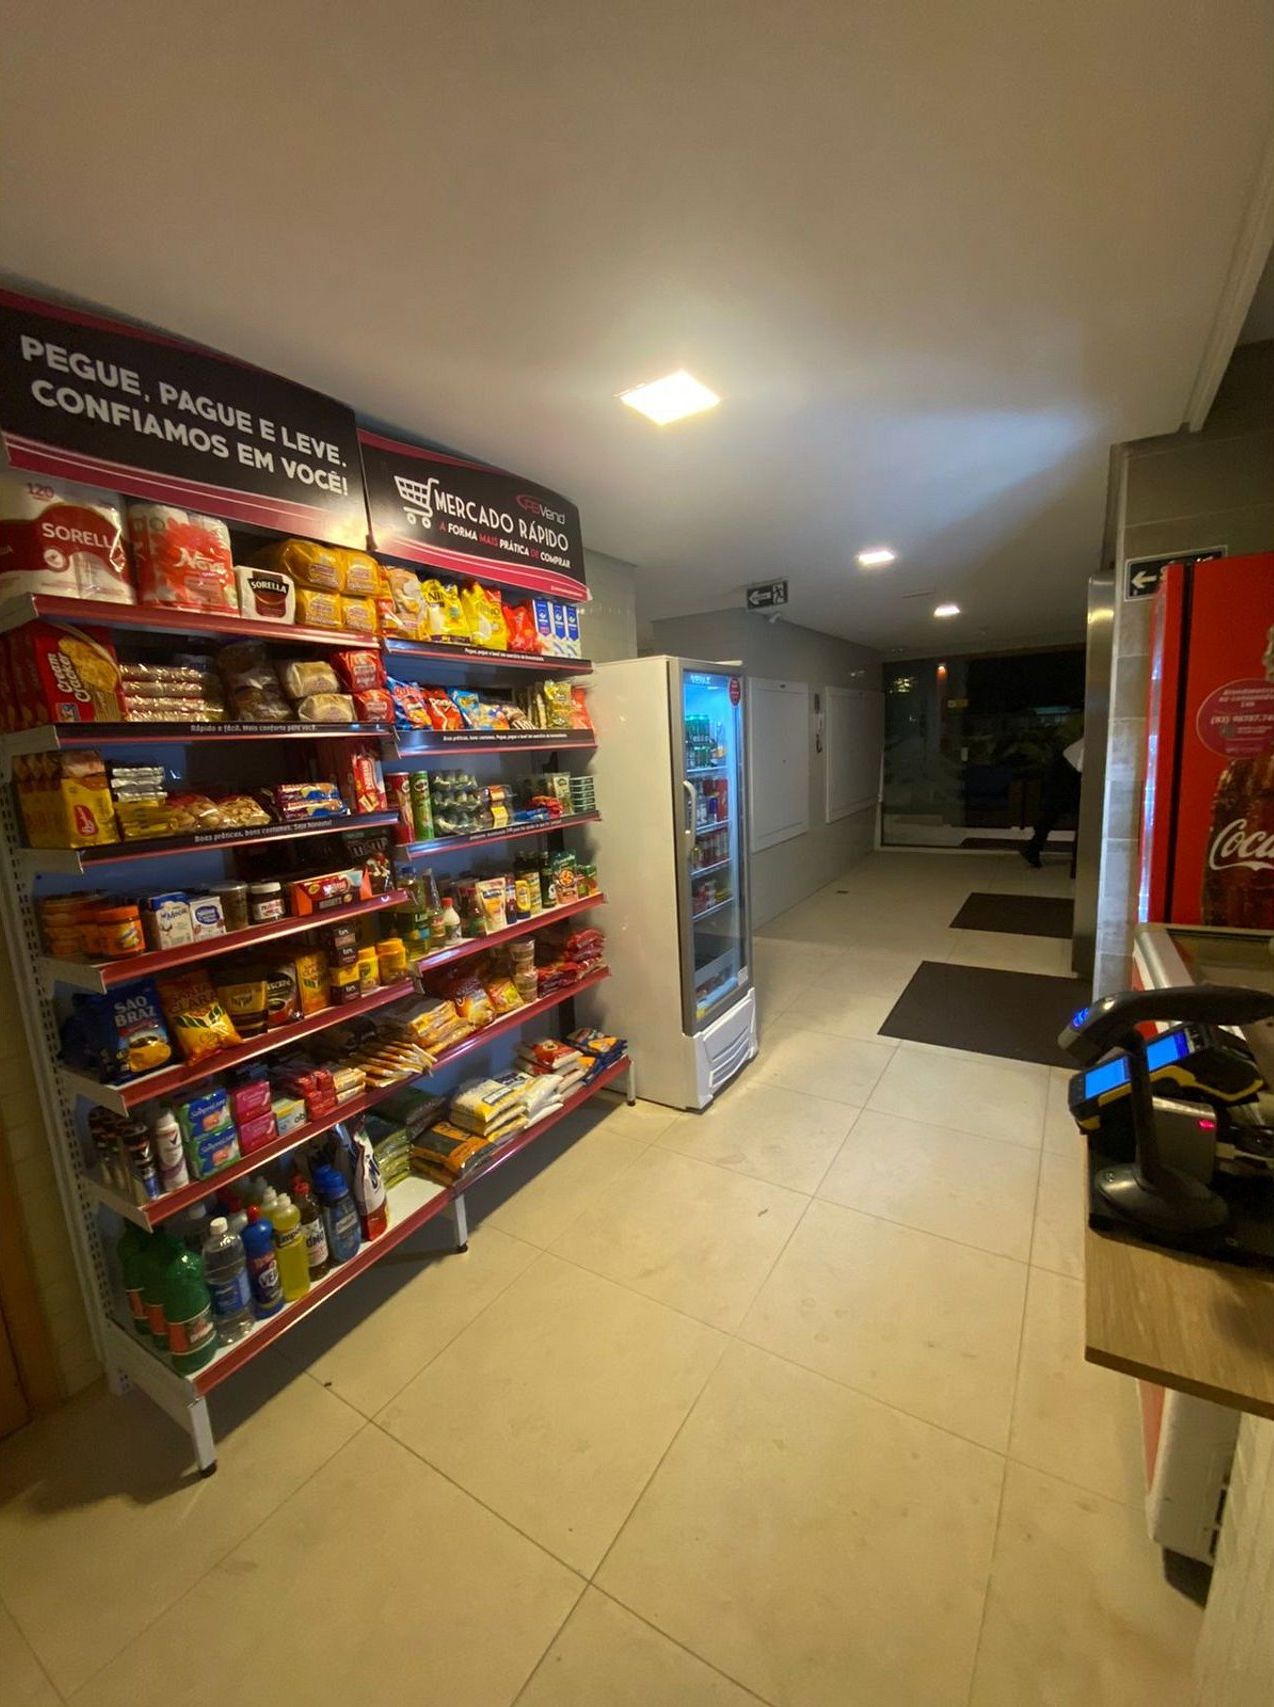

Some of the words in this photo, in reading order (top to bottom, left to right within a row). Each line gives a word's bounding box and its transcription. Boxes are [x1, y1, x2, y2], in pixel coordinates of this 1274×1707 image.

[21, 335, 150, 402] PEGUE,
[159, 382, 253, 434] PAGUE
[260, 418, 276, 442] E
[281, 425, 348, 467] LEVE.
[31, 379, 229, 459] CONFIAMOS
[238, 443, 274, 473] EM
[281, 457, 348, 496] VOCÊ!
[27, 482, 54, 499] 120
[434, 489, 514, 534] MERCADO
[519, 518, 569, 552] RÁPIDO
[438, 521, 447, 532] A
[448, 523, 478, 541] FORMA
[479, 532, 498, 547] MAIS
[499, 538, 530, 558] PRÁTICA
[540, 552, 571, 569] COMPRAR
[251, 580, 288, 594] SORELLA
[48, 653, 73, 693] Cream
[58, 651, 91, 703] Cracker
[114, 1007, 157, 1027] BRAZ
